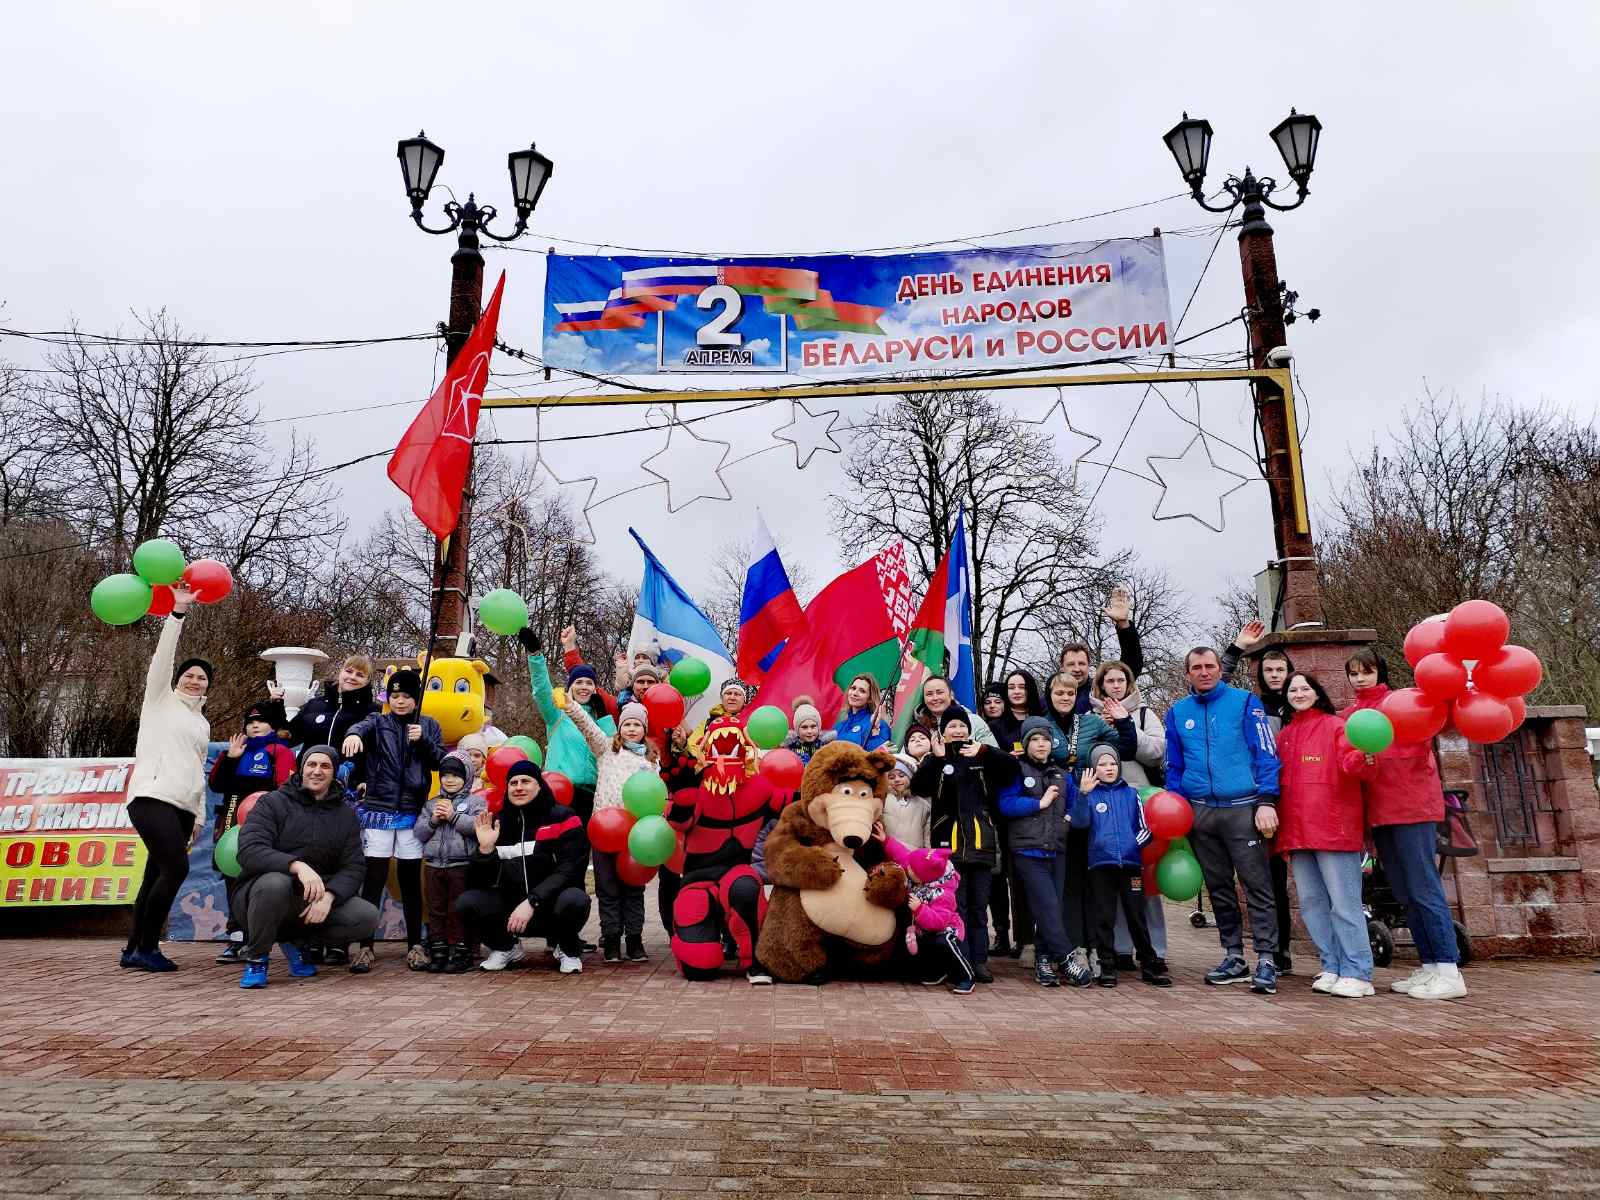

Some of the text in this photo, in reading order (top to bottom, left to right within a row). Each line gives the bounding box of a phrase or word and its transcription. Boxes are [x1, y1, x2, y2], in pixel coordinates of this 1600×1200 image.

[897, 264, 1112, 302] ДЕНЬ ЕДИНЕНИЯ
[696, 284, 742, 346] 2
[942, 298, 1073, 325] НАРОДОВ
[685, 349, 753, 366] АПРЕЛЯ
[803, 321, 1168, 367] БЕЛАРУСИ и РОССИИ
[4, 764, 129, 797] ТРЕЗВЫЙ
[0, 804, 33, 831] АЗ
